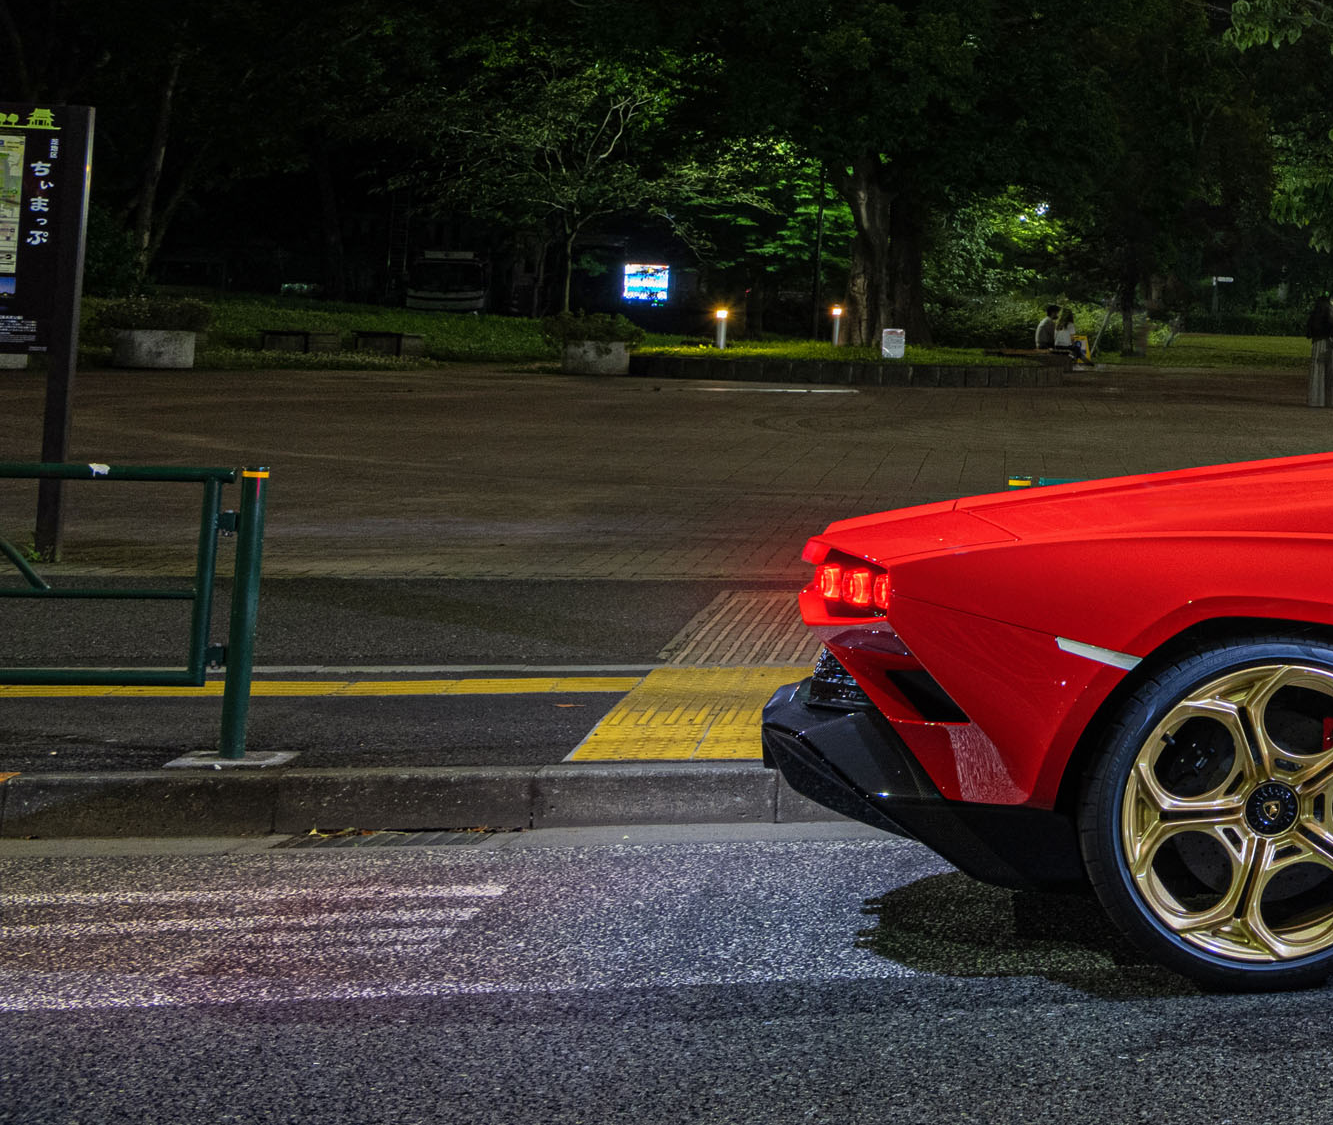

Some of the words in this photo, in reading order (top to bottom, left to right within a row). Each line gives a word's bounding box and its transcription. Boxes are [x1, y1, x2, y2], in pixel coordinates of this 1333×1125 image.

[26, 161, 54, 246] ちぃまっぷ
